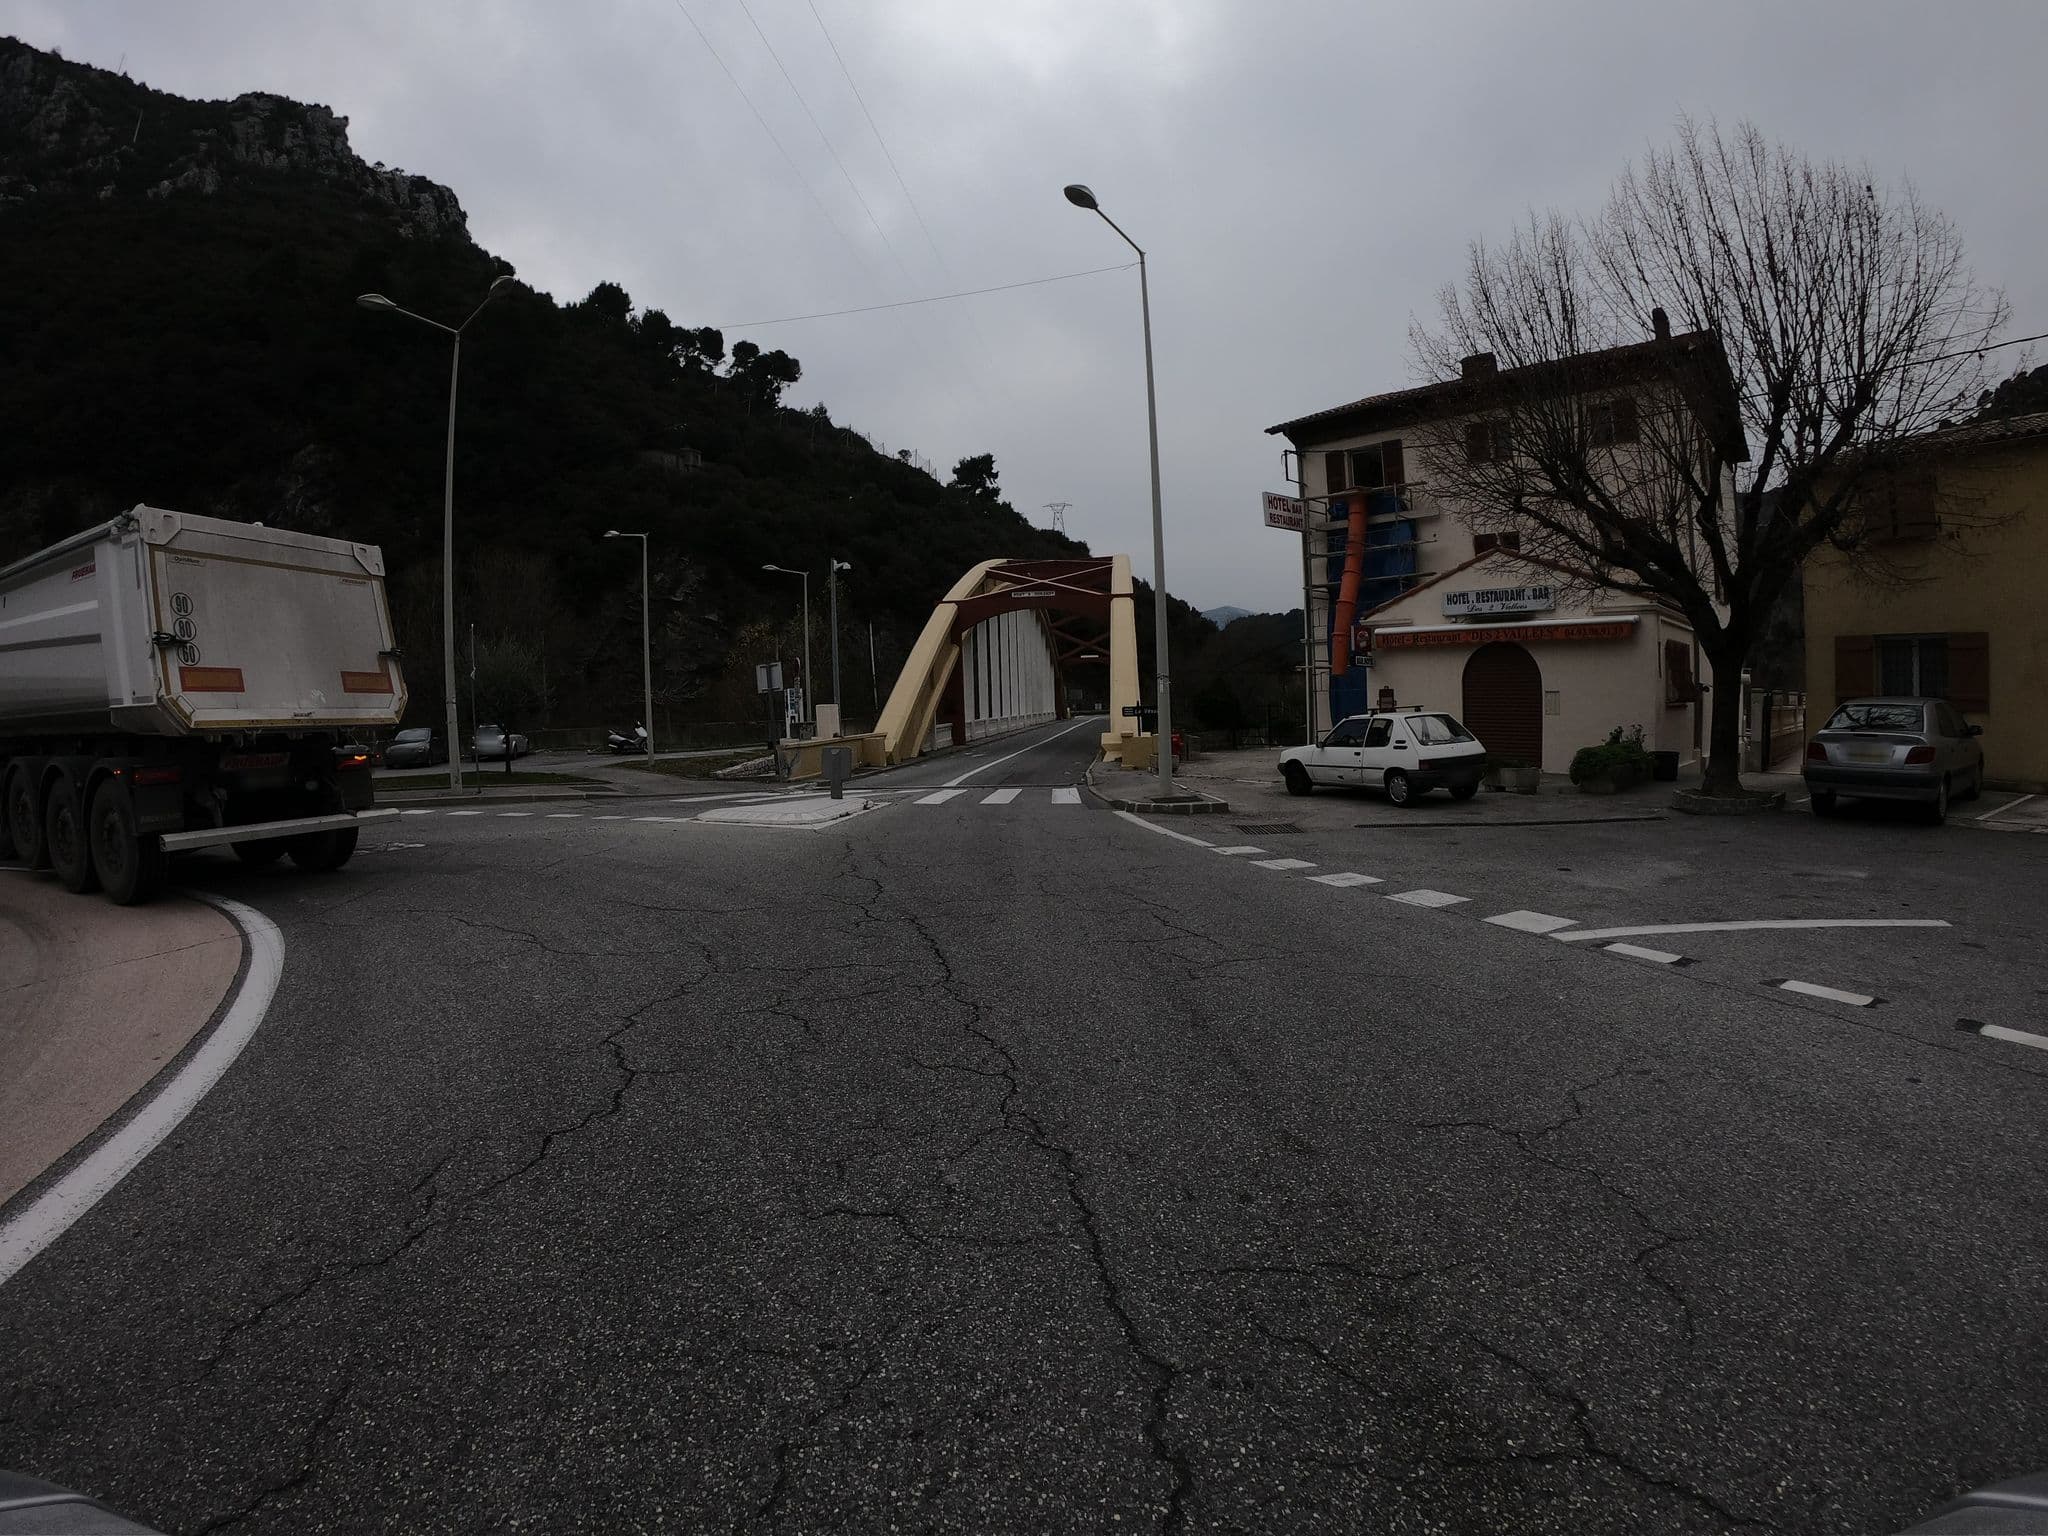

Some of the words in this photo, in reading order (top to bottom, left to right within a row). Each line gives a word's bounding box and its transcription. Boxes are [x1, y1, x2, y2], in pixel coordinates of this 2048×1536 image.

[1267, 495, 1291, 512] HOTEL
[1269, 512, 1303, 528] RESTAURANT
[175, 595, 188, 613] 90
[1446, 592, 1470, 605] HOTEL
[1476, 588, 1526, 604] RESTAURANT
[1532, 587, 1549, 600] BAR
[178, 620, 192, 638] 80
[182, 645, 196, 663] 60
